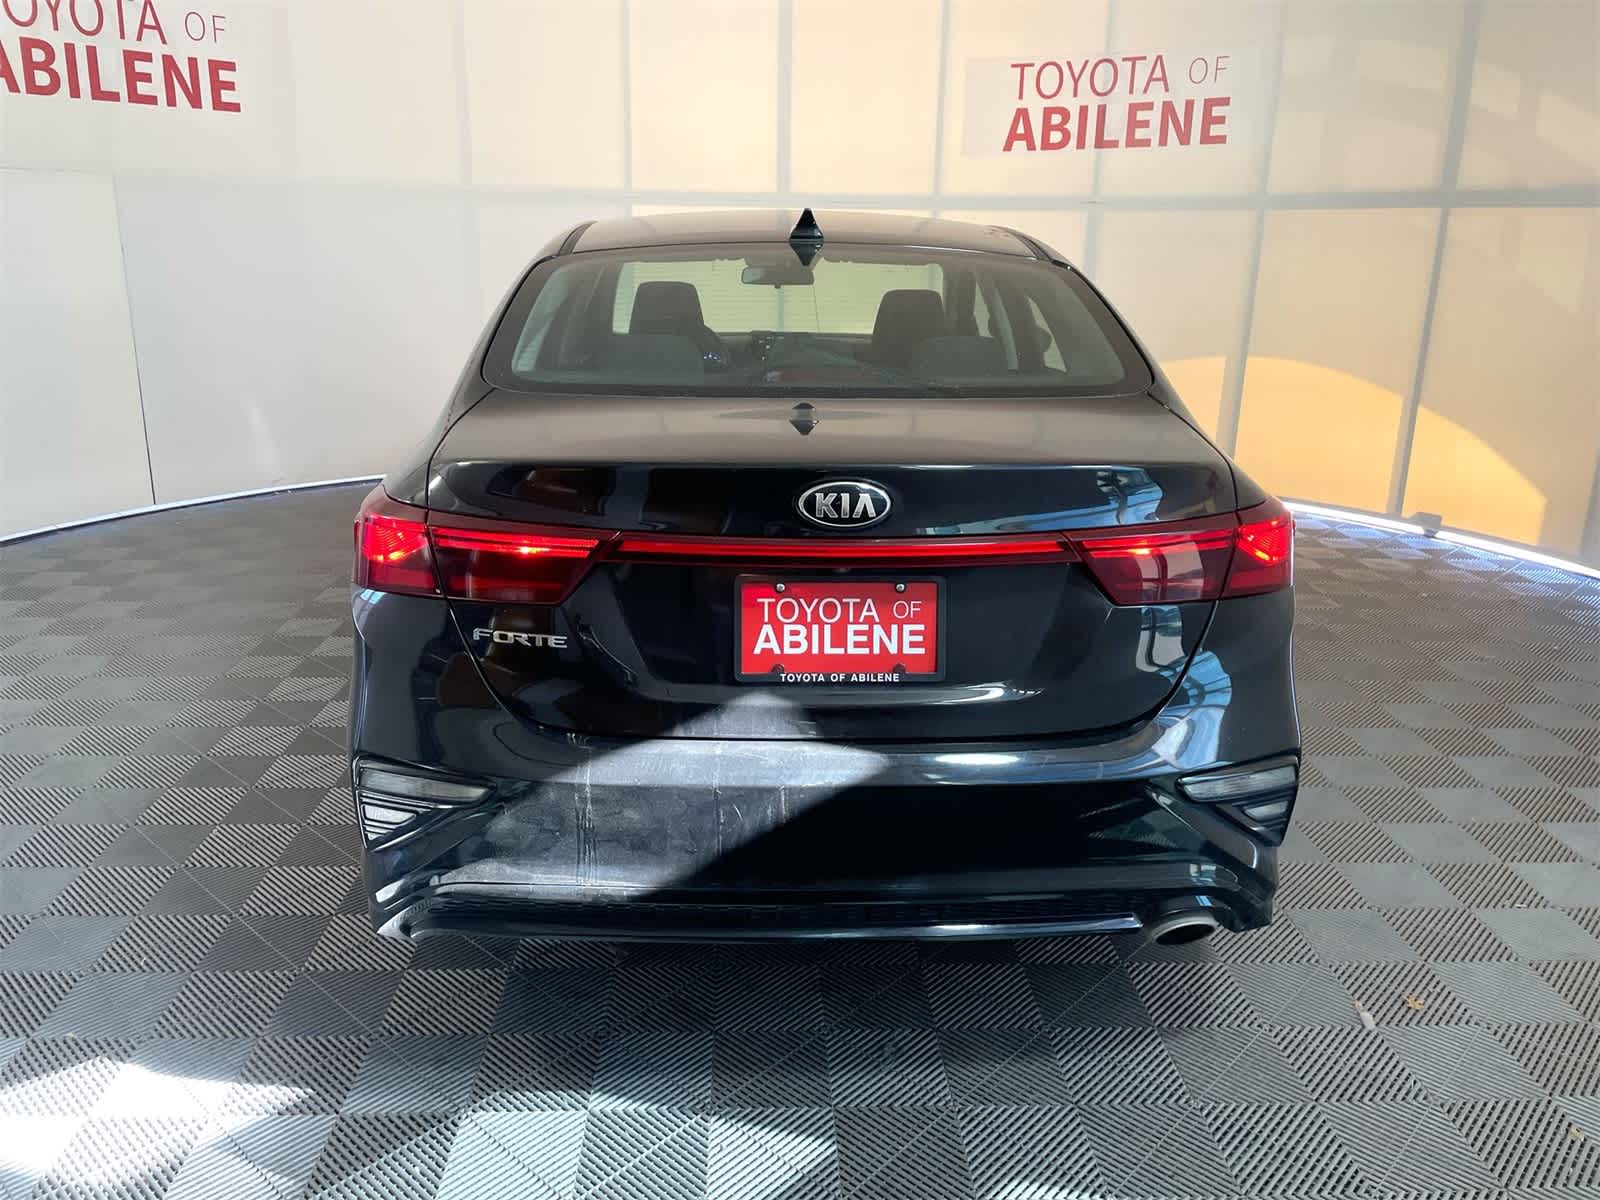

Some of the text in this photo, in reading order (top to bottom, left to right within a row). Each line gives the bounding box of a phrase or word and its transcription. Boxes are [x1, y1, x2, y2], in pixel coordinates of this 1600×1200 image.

[1, 0, 226, 45] OYOTA OF
[1010, 54, 1230, 100] TOYOTA OF
[1002, 96, 1231, 152] ABILENE
[814, 492, 877, 518] KIA
[756, 598, 922, 623] TOYOTA OF
[472, 627, 568, 648] FORTE
[753, 623, 926, 655] ABILENE
[780, 673, 900, 682] TOYOTA OF ABILENE
